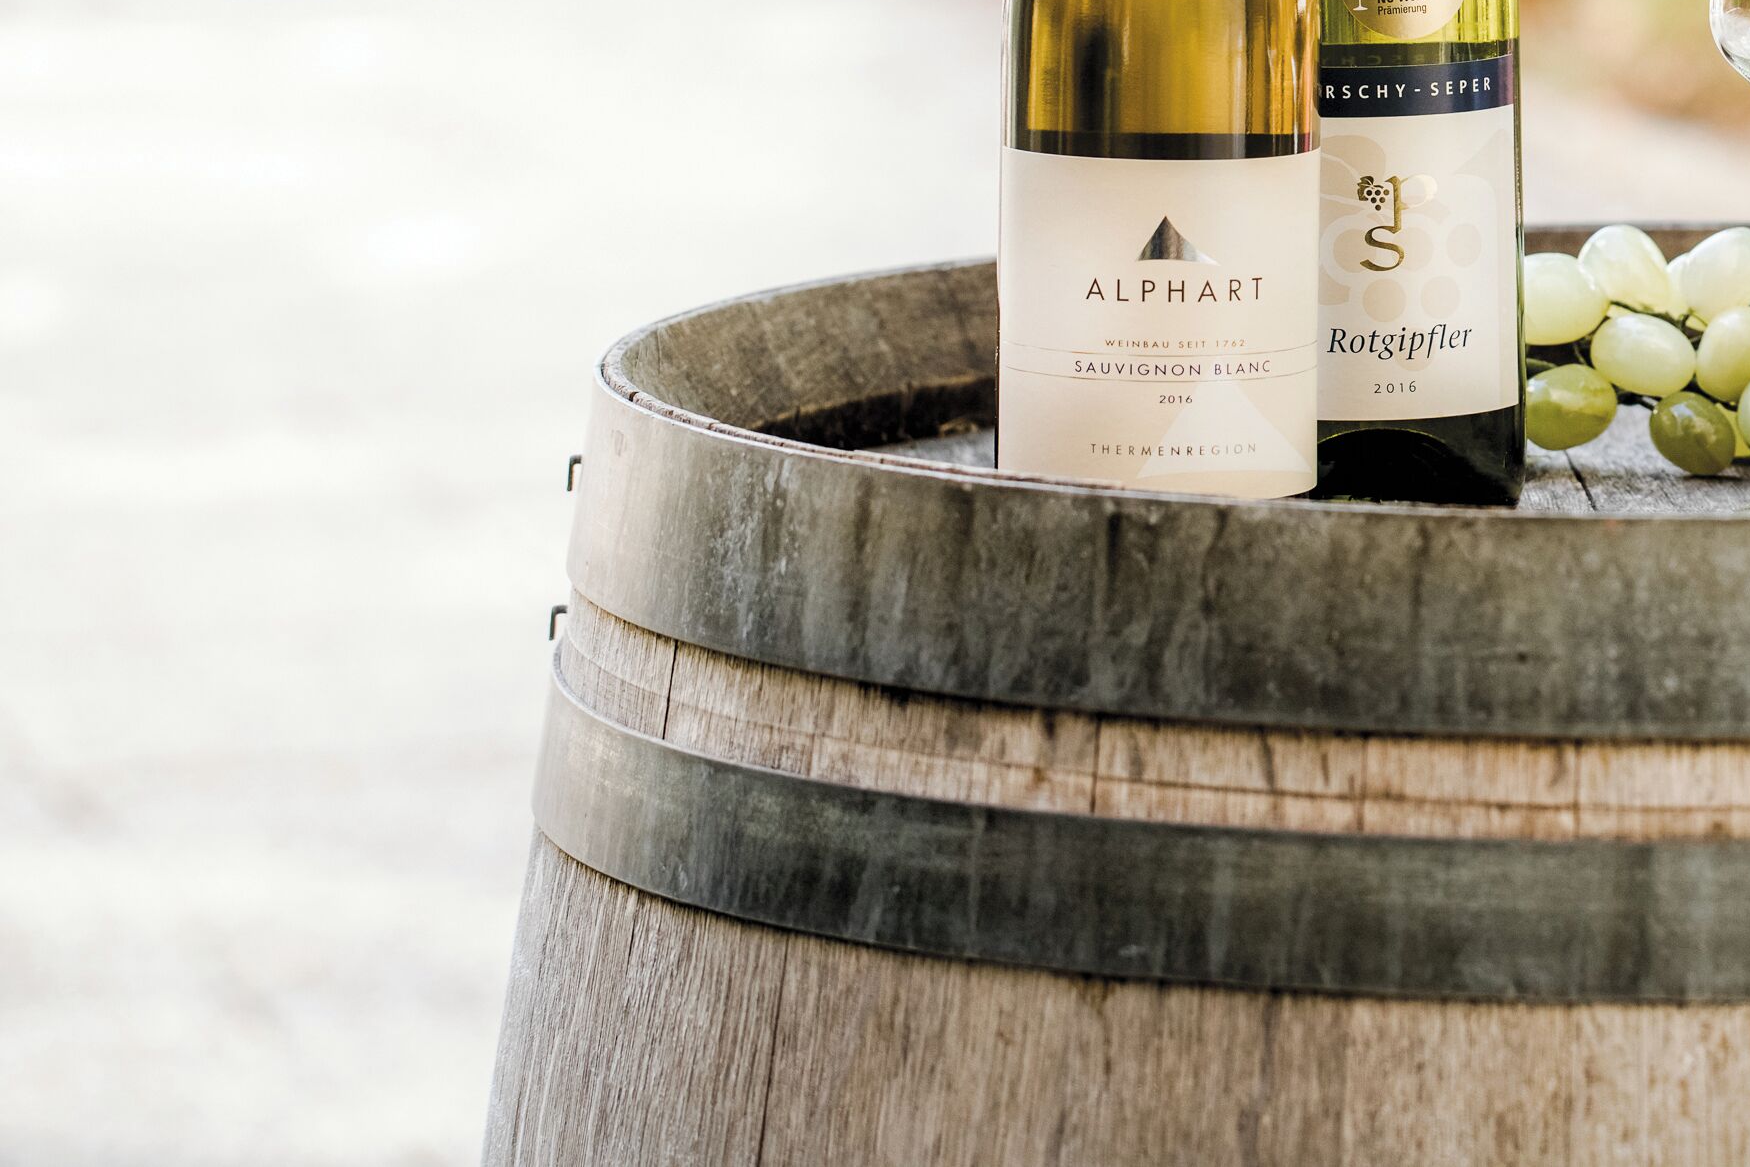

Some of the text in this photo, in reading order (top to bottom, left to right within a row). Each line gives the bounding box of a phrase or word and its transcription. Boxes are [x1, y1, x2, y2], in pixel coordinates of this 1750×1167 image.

[1377, 4, 1427, 16] Prämierung
[1085, 277, 1263, 303] ALPHART
[1105, 339, 1246, 349] WEINBAU SEIT 1762
[1326, 323, 1473, 361] Rotgipfler
[1074, 360, 1271, 376] SAUVIGNON BLANC
[1374, 380, 1417, 394] 2016
[1159, 394, 1193, 404] 2016
[1091, 443, 1257, 457] THERMENREGION
